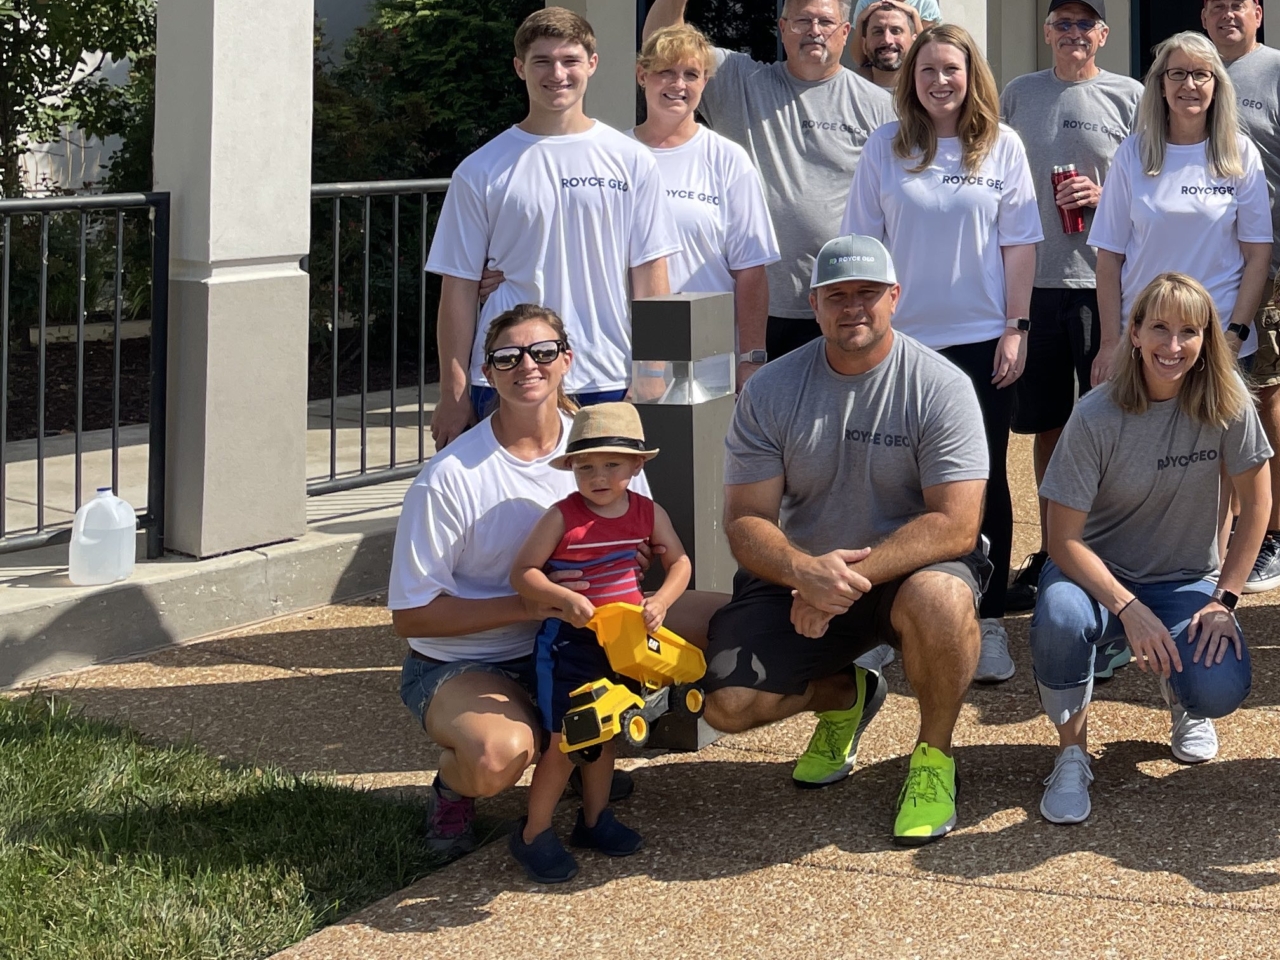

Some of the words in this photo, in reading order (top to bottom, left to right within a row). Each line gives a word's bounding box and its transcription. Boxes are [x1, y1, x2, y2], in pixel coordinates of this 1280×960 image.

[1241, 98, 1263, 110] GEO
[801, 120, 838, 131] ROYCE
[1063, 120, 1099, 132] ROYCE
[561, 176, 605, 189] ROYCE
[942, 175, 984, 186] ROYCE
[845, 428, 882, 446] ROYE
[1190, 449, 1218, 463] GEO
